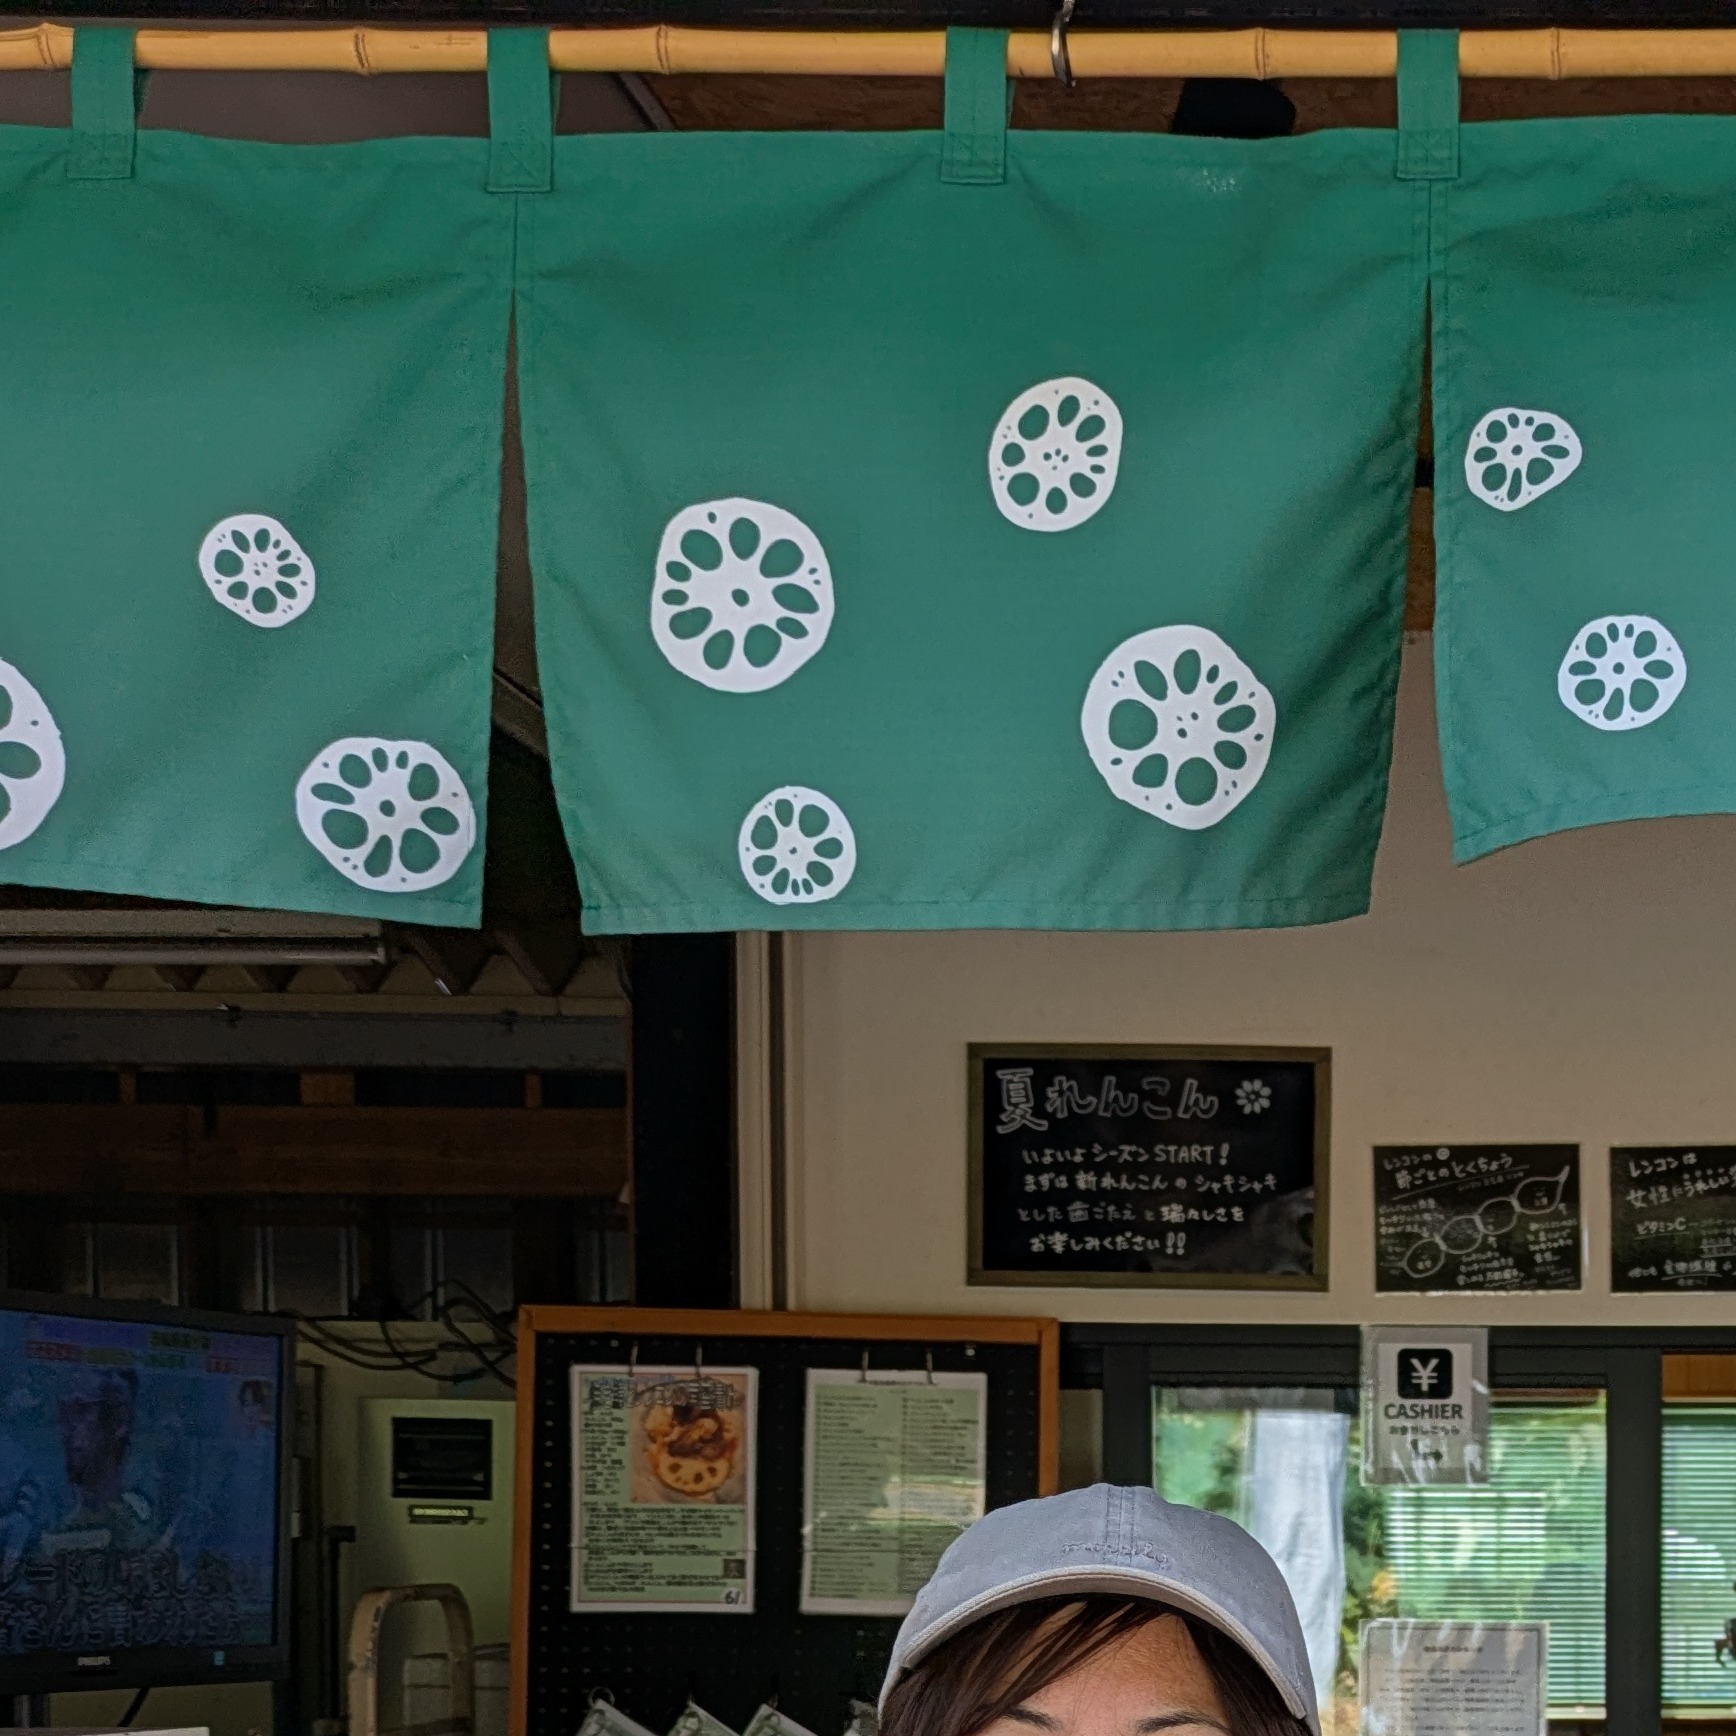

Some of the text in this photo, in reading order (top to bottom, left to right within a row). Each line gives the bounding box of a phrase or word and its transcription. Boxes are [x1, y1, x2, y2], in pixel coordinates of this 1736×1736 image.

[995, 1067, 1219, 1134] 夏れんこん
[1384, 1403, 1464, 1420] CASHIER
